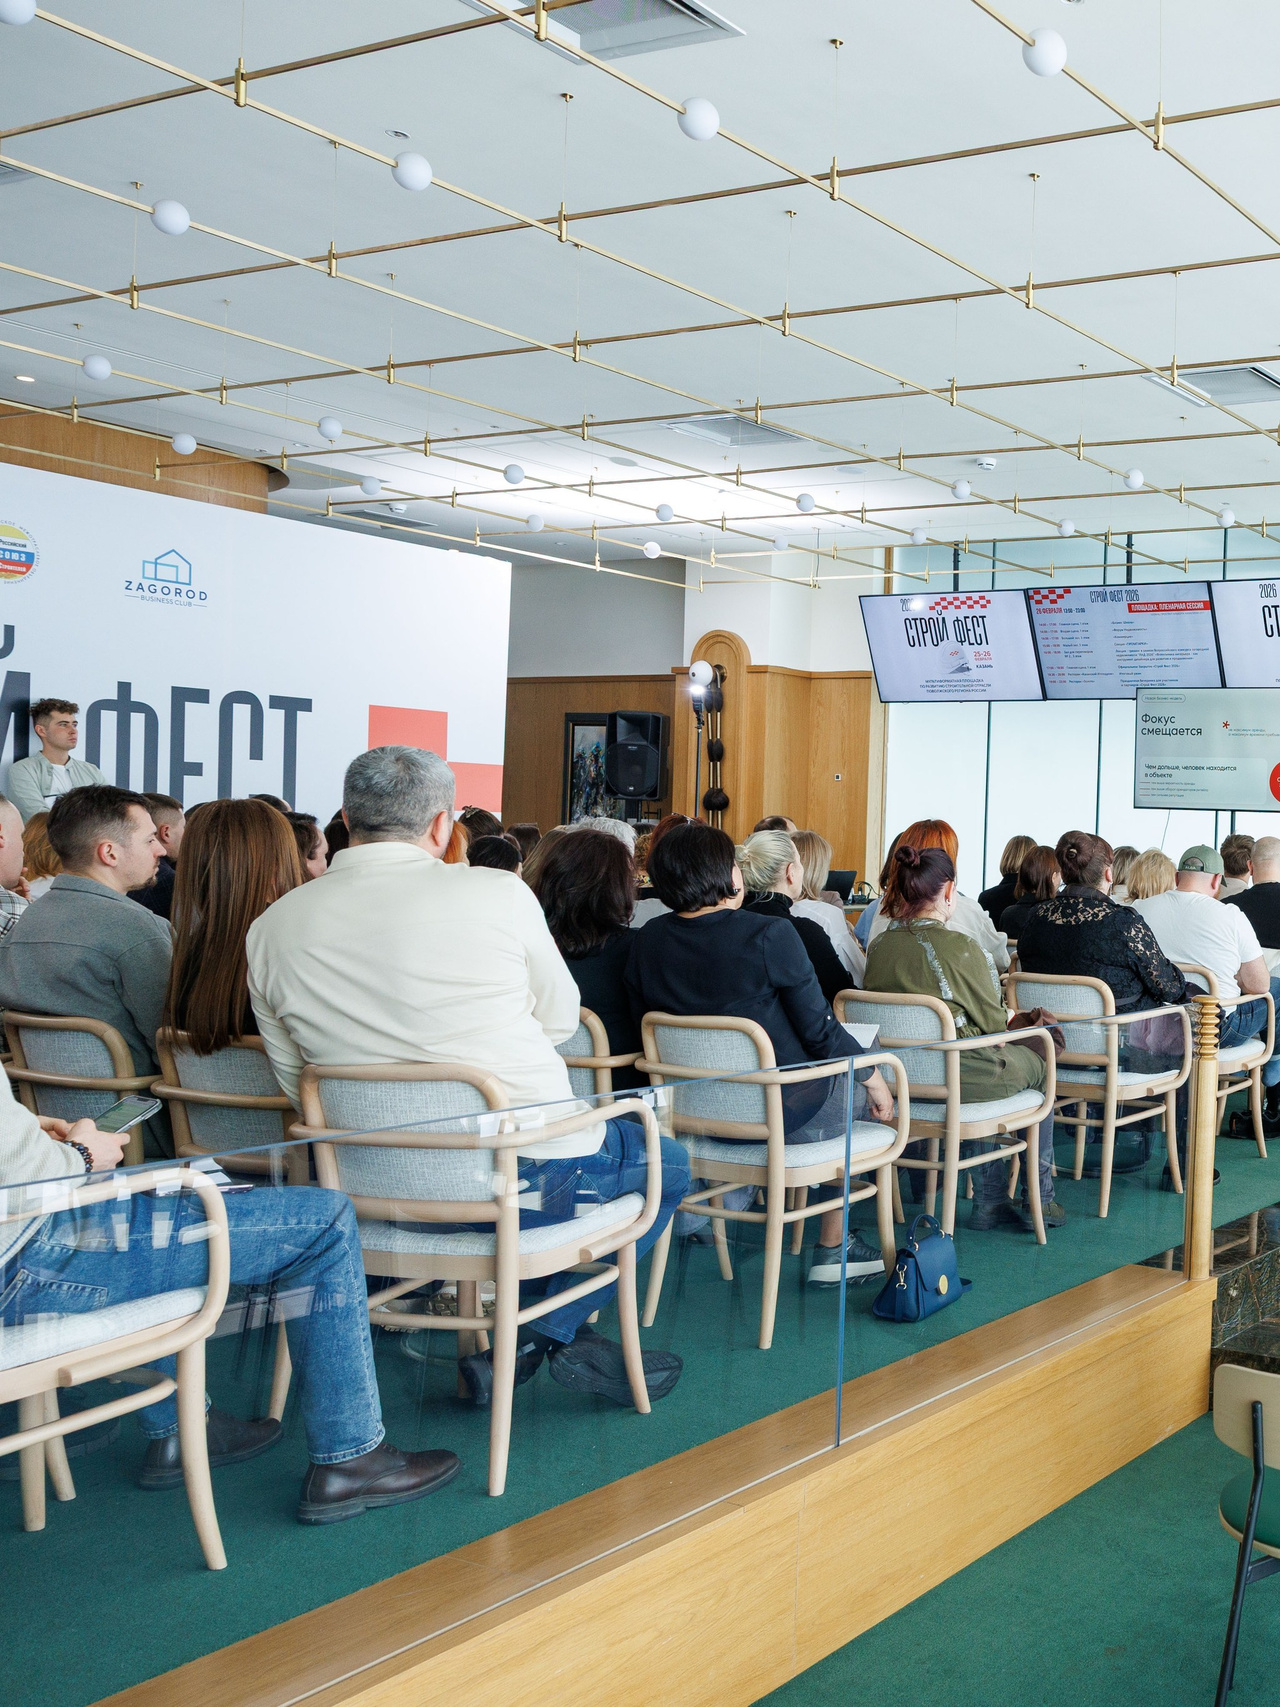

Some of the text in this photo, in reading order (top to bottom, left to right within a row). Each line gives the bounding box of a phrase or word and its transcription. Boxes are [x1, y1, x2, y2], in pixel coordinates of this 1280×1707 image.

[124, 580, 208, 601] ZAGOROD
[1090, 588, 1140, 603] СТРОЙ ФЕСТ 2026
[1259, 583, 1277, 598] 2026
[140, 594, 192, 607] BUSINESS CLUB
[904, 610, 989, 647] СТРОЙ ФЕСТ
[1141, 713, 1176, 726] Фокус
[1141, 727, 1202, 737] смещается
